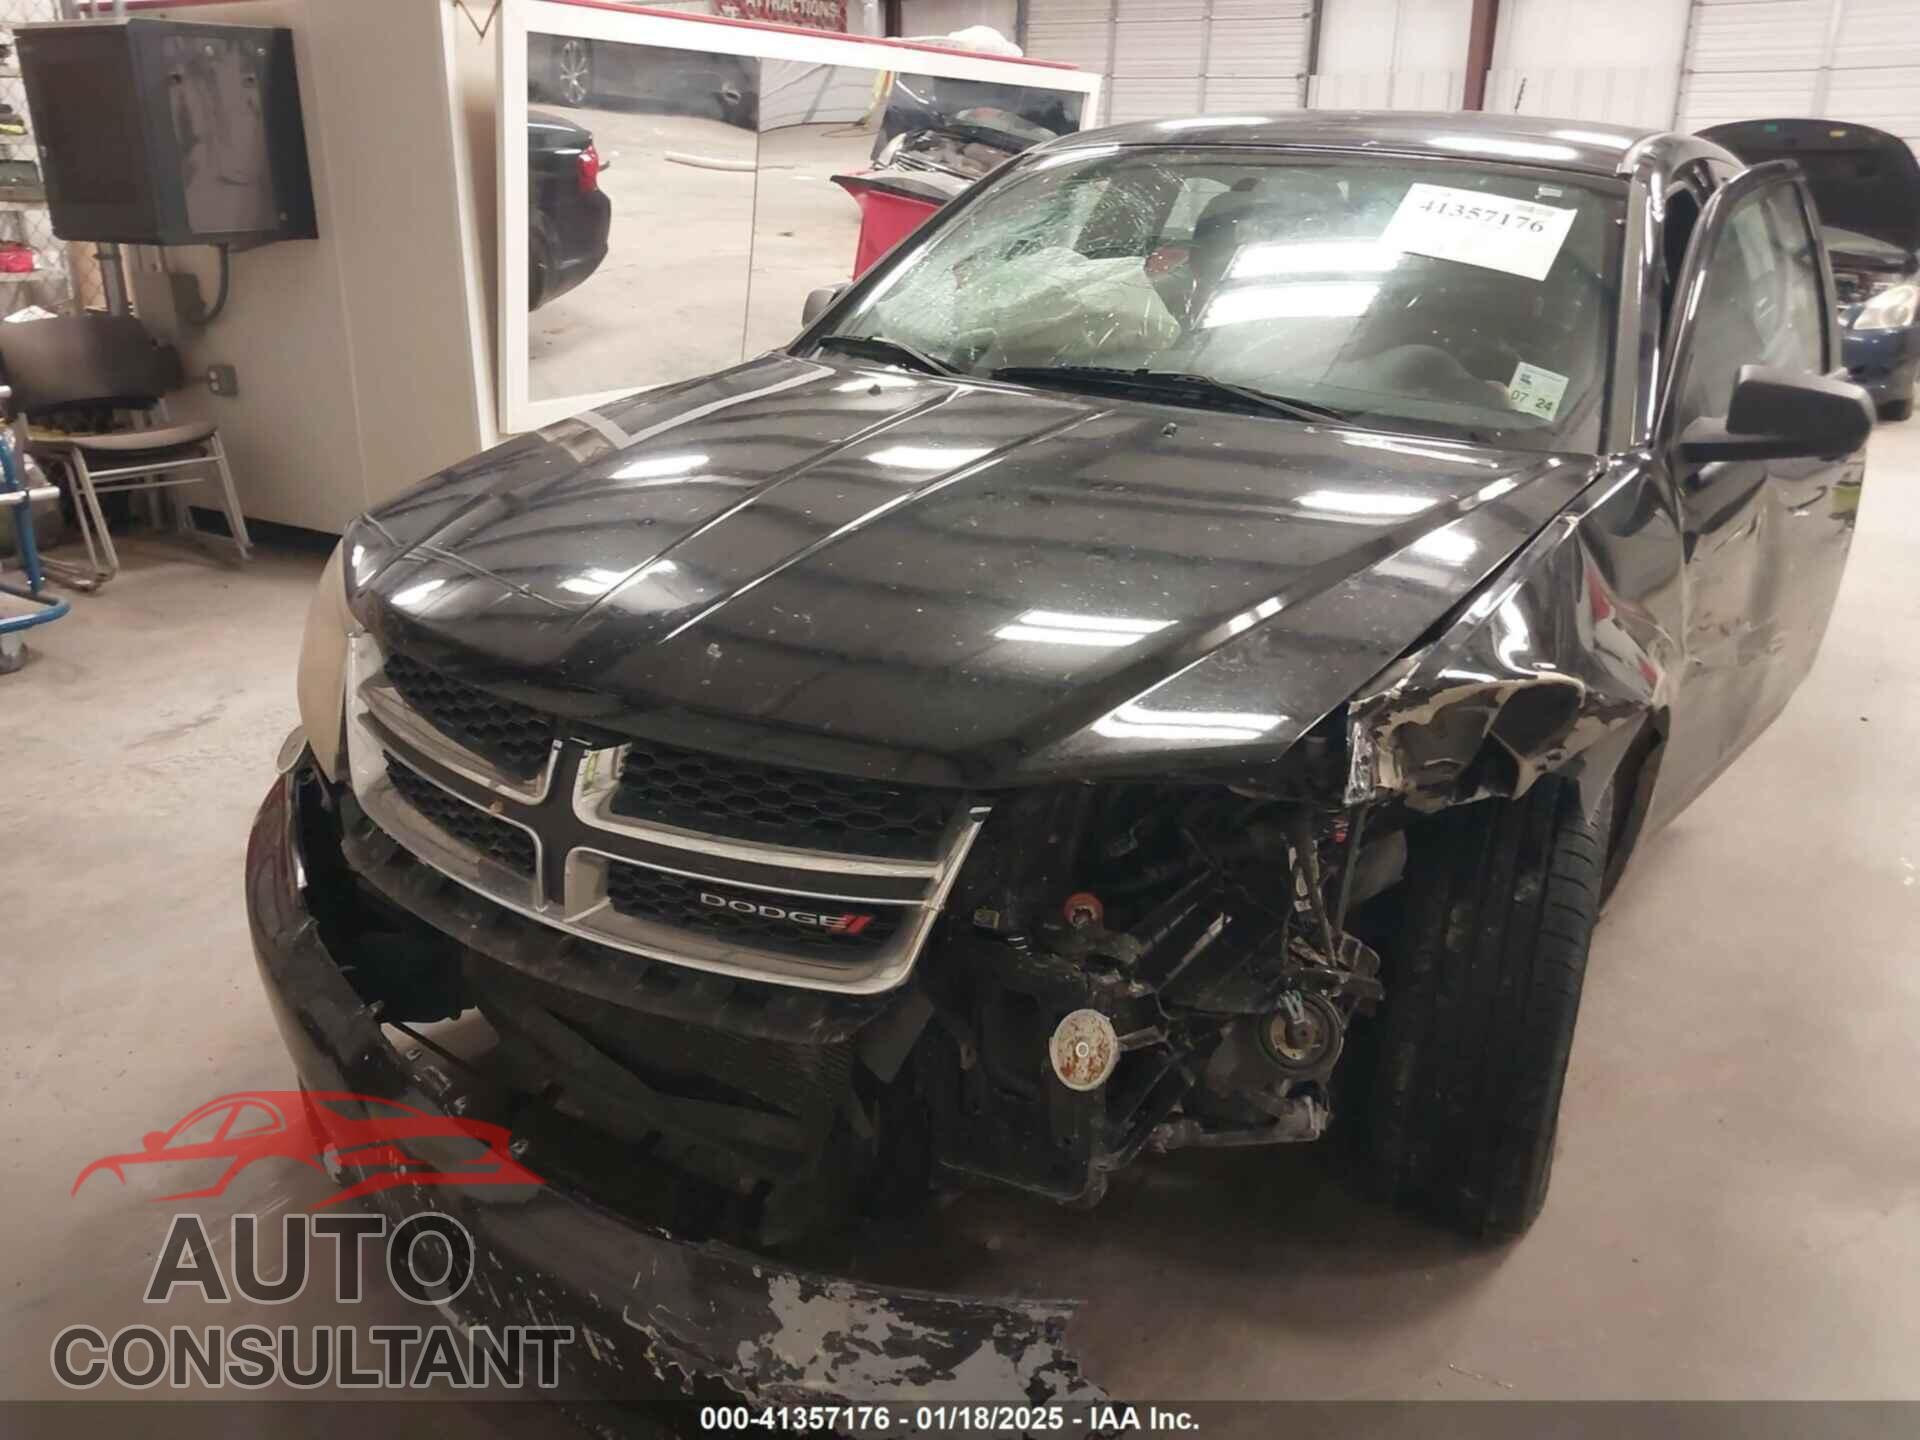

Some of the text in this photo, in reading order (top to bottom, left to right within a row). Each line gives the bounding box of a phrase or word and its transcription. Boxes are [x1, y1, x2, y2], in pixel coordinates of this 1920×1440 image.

[1419, 200, 1545, 233] 41357176
[1510, 390, 1554, 412] 07 24
[699, 892, 848, 929] DODGE
